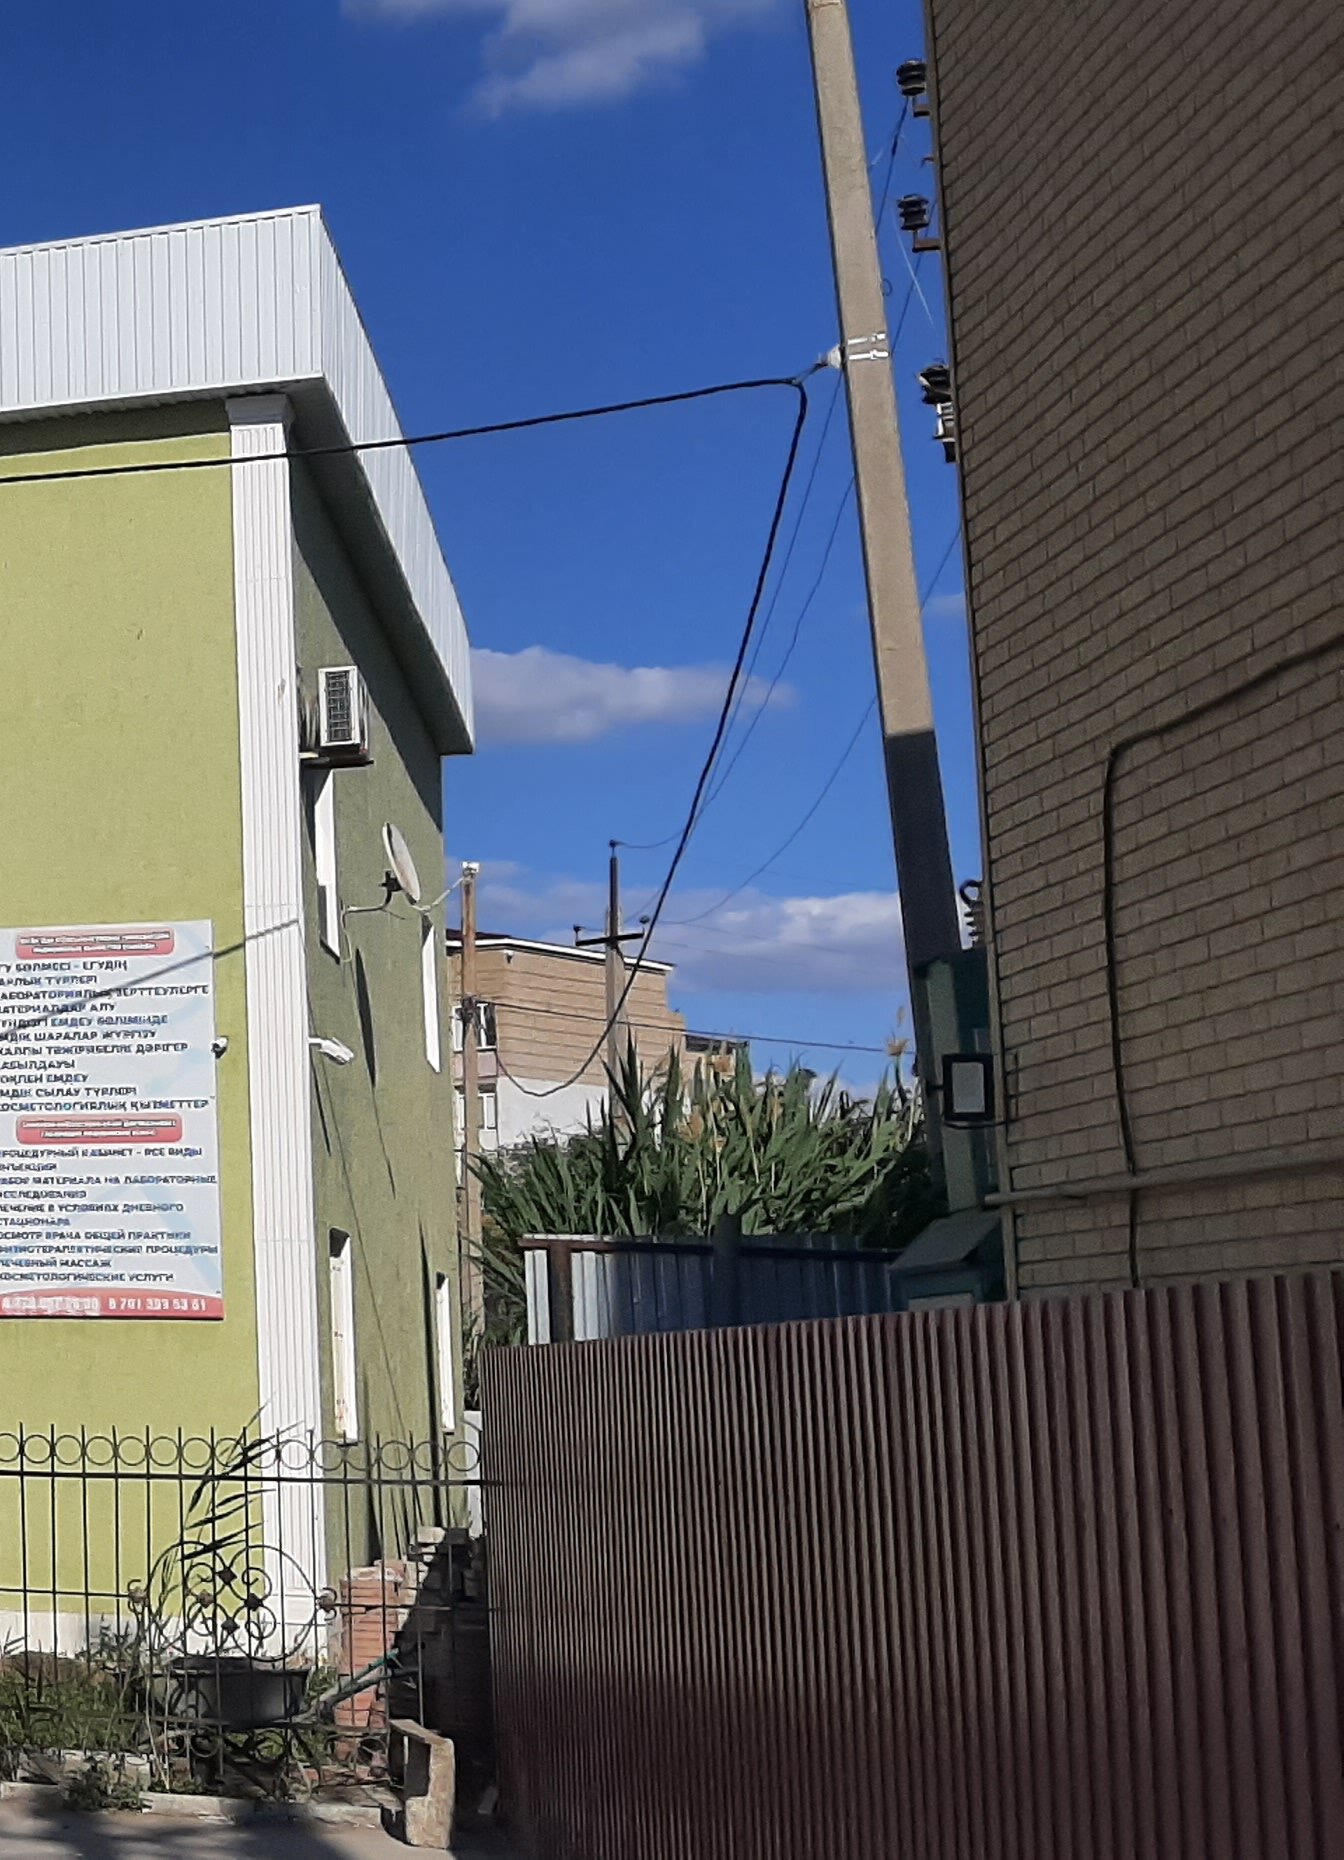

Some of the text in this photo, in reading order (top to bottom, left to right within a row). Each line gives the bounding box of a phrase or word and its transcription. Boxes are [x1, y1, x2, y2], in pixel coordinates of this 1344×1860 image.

[34, 1031, 97, 1040] ШАРАЛАР
[45, 1231, 82, 1240] ВРАЧА
[59, 1259, 111, 1268] МАССАЖ
